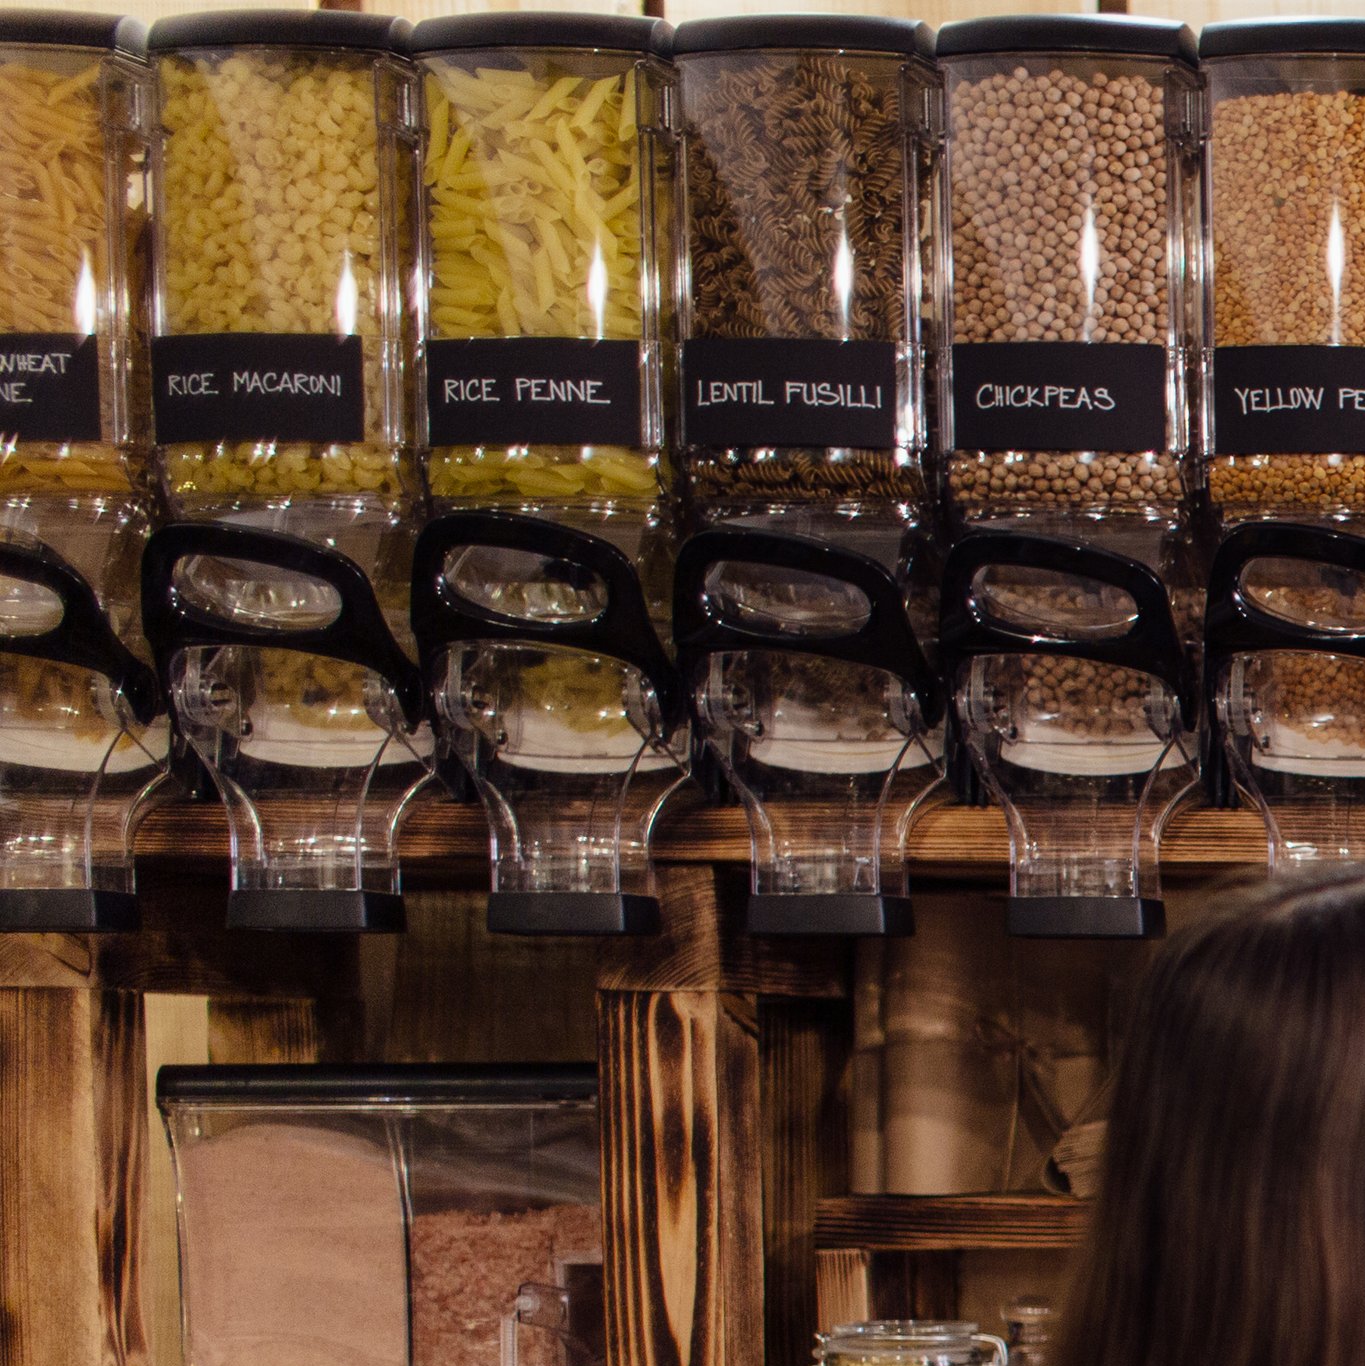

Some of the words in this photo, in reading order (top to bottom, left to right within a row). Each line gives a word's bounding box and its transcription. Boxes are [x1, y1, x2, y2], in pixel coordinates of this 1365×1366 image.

[168, 372, 219, 396] RICE
[233, 371, 341, 397] MACARONI
[444, 378, 501, 404] RICE
[515, 377, 612, 405] PENNE
[697, 379, 775, 407] LENTIL
[785, 381, 882, 409] FUSILLI
[976, 383, 1116, 411] CHICKPEAS
[1234, 386, 1325, 415] YELLOW
